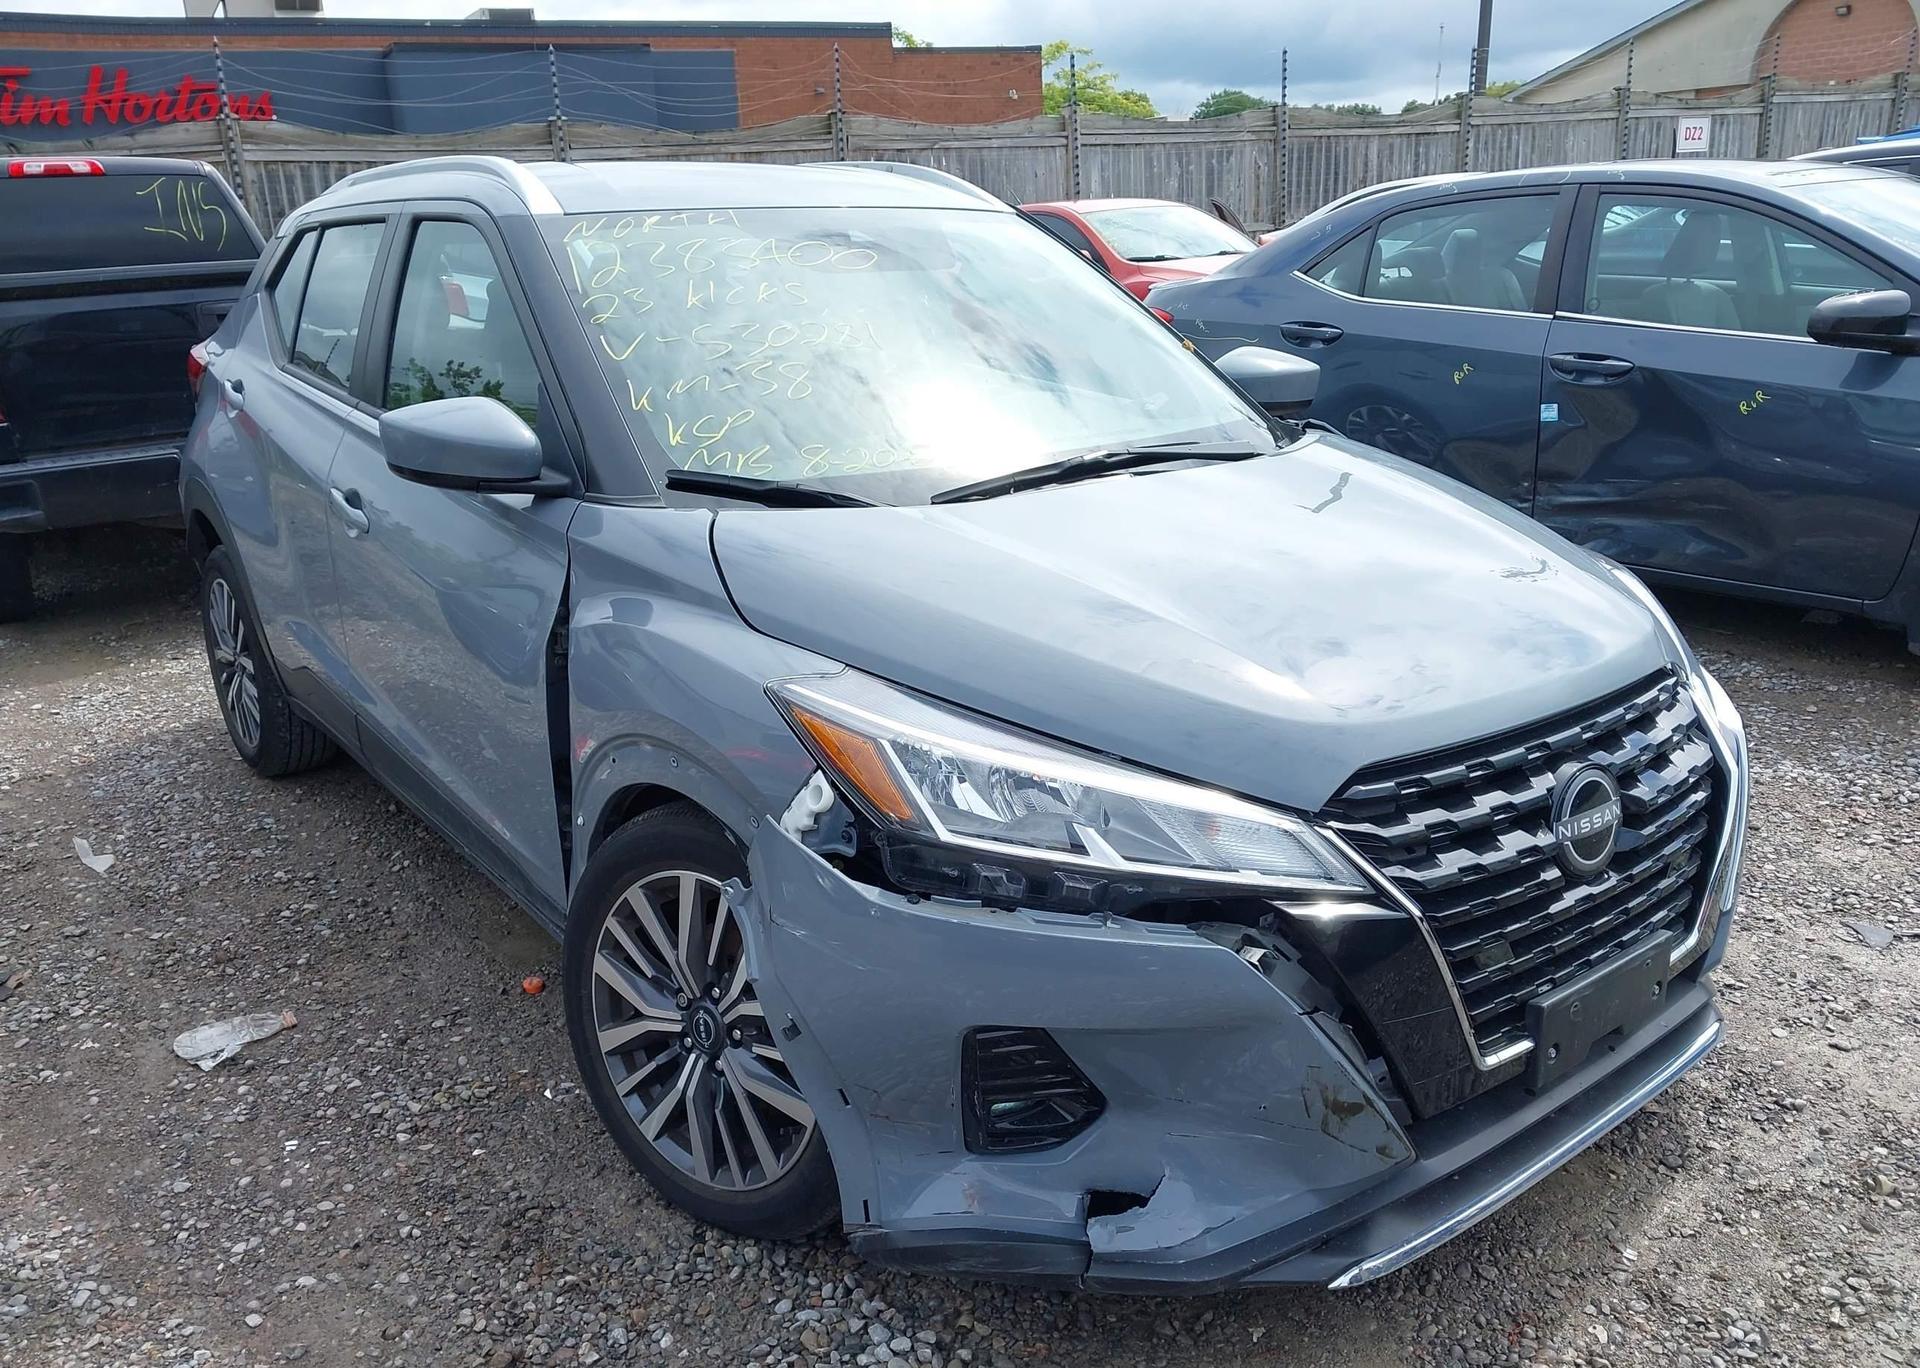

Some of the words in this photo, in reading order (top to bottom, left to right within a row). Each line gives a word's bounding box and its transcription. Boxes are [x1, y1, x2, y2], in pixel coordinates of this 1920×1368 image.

[81, 64, 274, 126] Hortons
[1684, 126, 1704, 141] DZ2
[135, 176, 227, 251] INS
[563, 209, 741, 242] NORTH
[582, 284, 655, 324] 23
[1558, 801, 1621, 840] NISSAN
